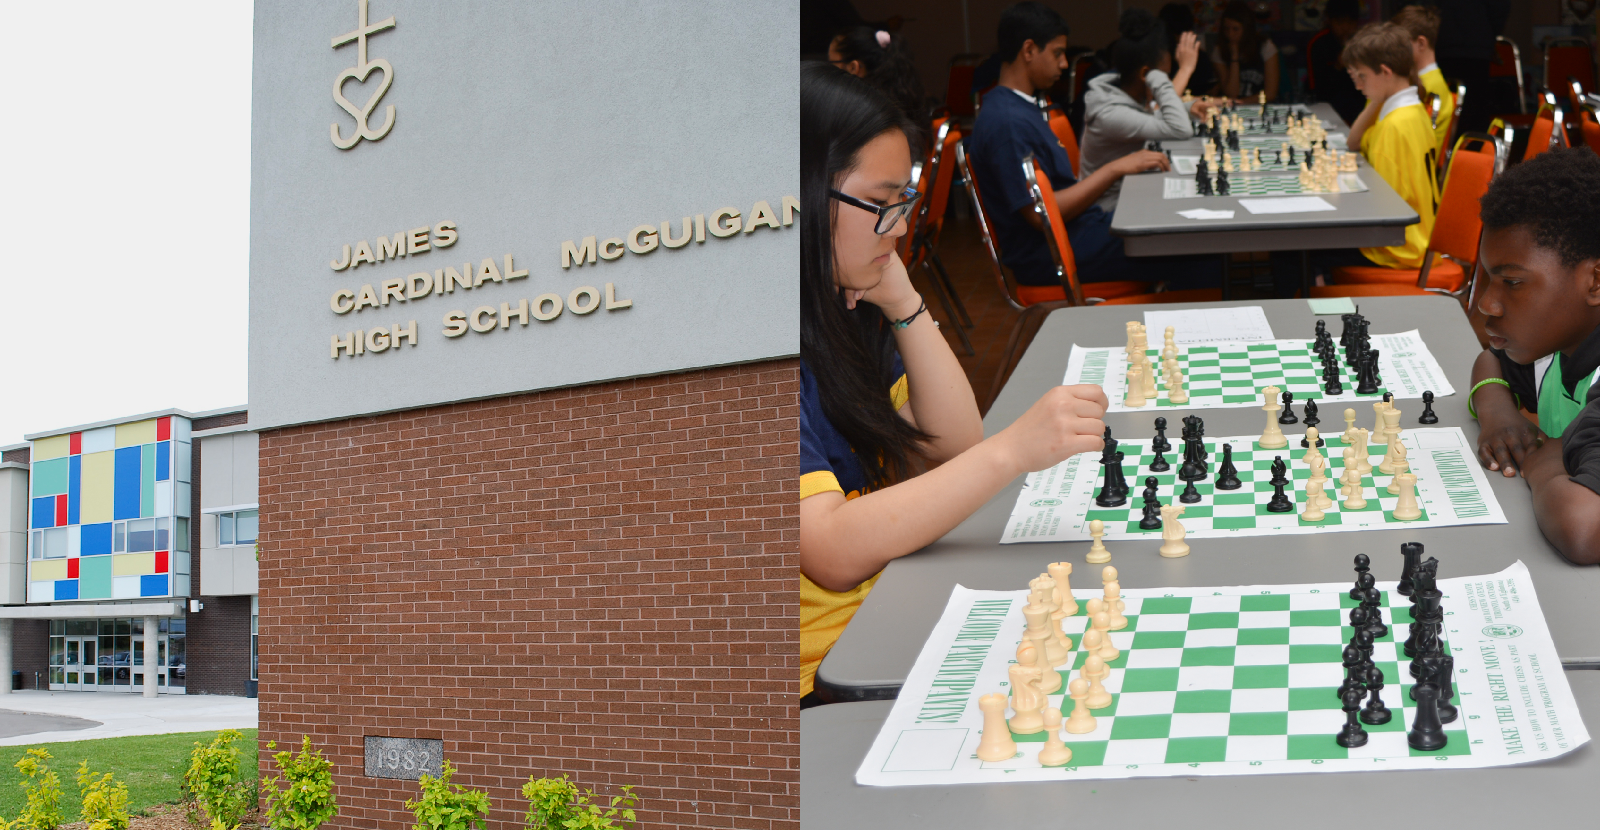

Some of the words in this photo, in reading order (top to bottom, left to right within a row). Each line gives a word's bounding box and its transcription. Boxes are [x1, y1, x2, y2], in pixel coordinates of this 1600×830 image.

[330, 220, 459, 271] JAMES
[330, 253, 530, 315] CARDINAL
[561, 195, 800, 270] McGUIGAN
[330, 320, 418, 360] HIGH
[442, 282, 633, 338] SCHOOL
[955, 599, 1013, 641] WELCOME
[1514, 666, 1526, 682] CHESS
[1528, 653, 1541, 673] SCHOOL
[915, 644, 992, 723] PARTICIPANTS!
[1487, 673, 1509, 701] RIGHT
[1537, 683, 1553, 708] PROGRAM
[1495, 705, 1515, 724] THE
[1546, 710, 1559, 725] MATH
[1501, 727, 1525, 755] MAKE
[378, 749, 430, 772] 1982
